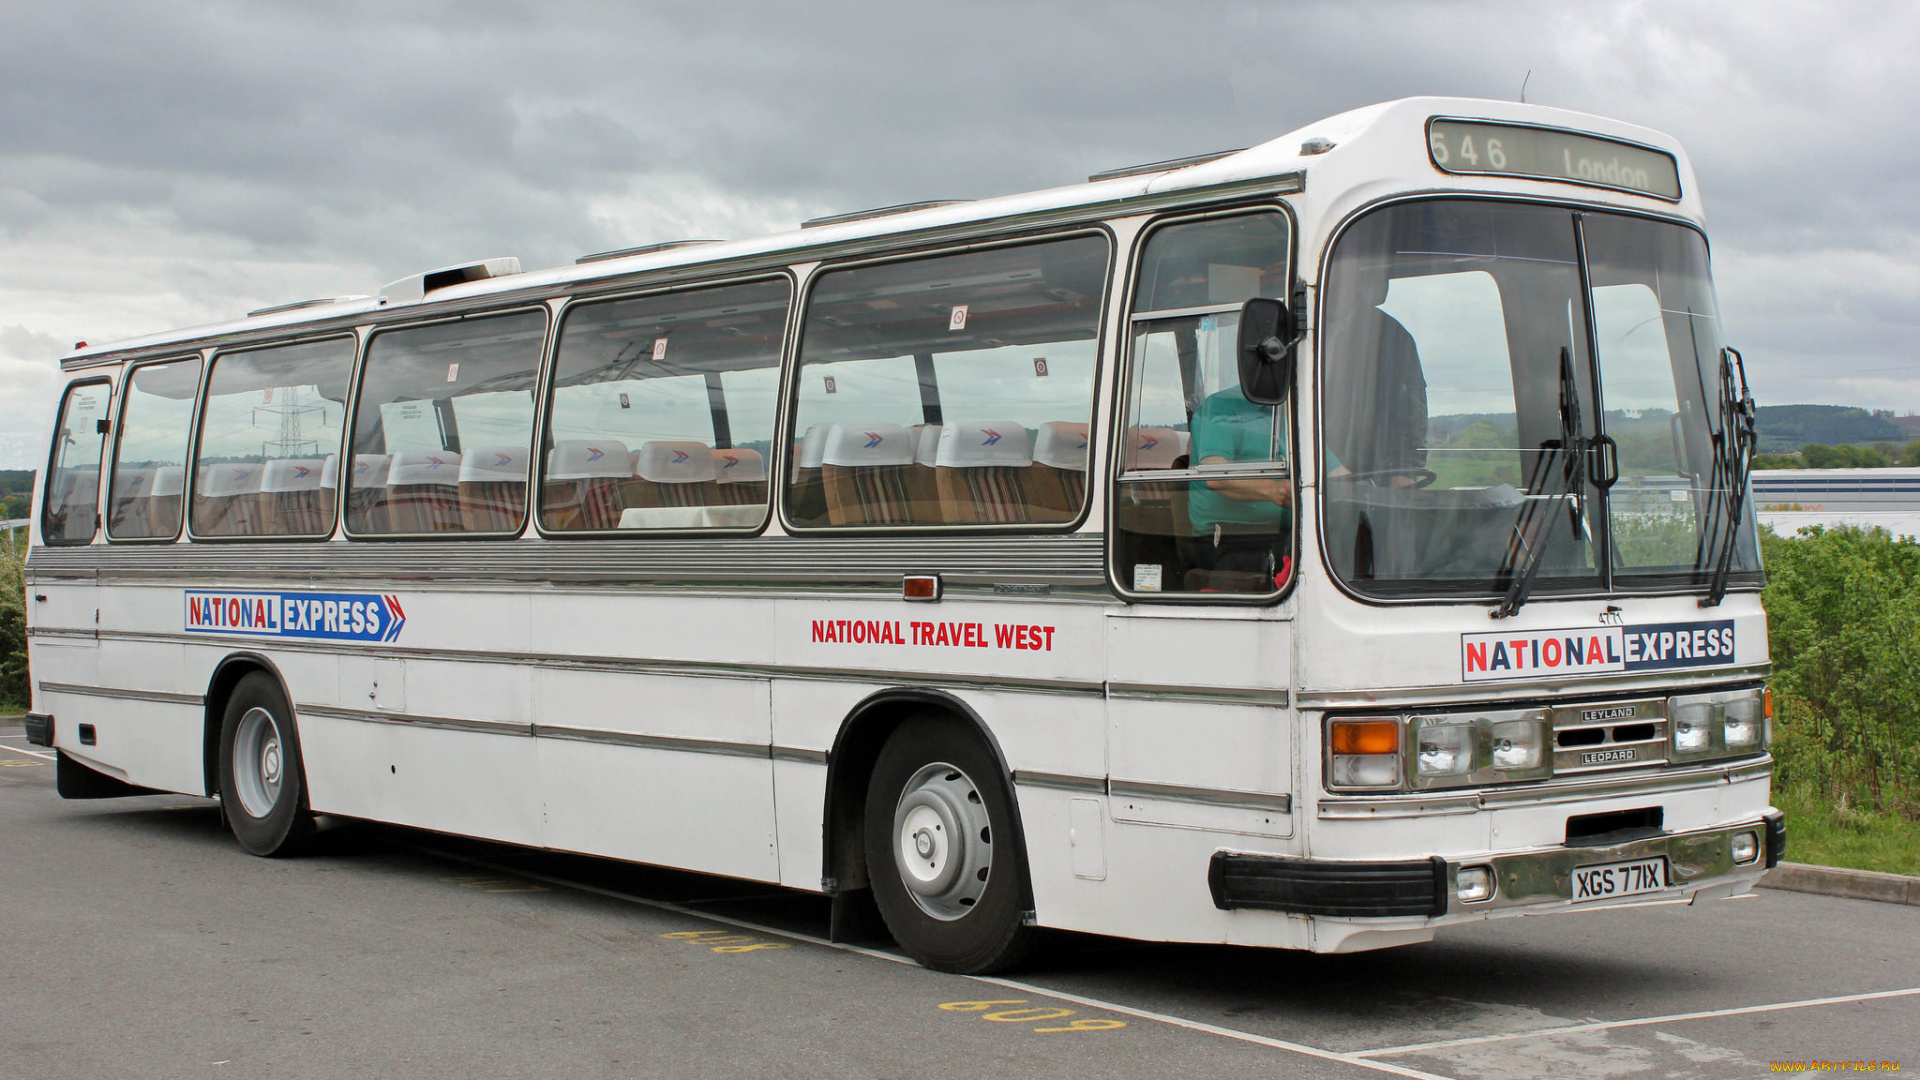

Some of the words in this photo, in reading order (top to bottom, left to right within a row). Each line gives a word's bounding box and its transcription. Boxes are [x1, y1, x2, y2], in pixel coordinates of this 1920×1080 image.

[1563, 148, 1650, 190] London
[189, 596, 278, 629] NATIONAL
[283, 599, 380, 635] EXPRESS
[812, 620, 906, 645] NATIONAL
[910, 621, 989, 648] TRAVEL
[995, 623, 1056, 651] WEST
[1466, 634, 1622, 673] NATIONAL
[1623, 627, 1734, 663] EXPRESS
[1583, 707, 1634, 721] LEYLAND
[1583, 749, 1635, 764] LEOPARD
[1576, 868, 1616, 898] XGS
[1618, 862, 1660, 892] 771X
